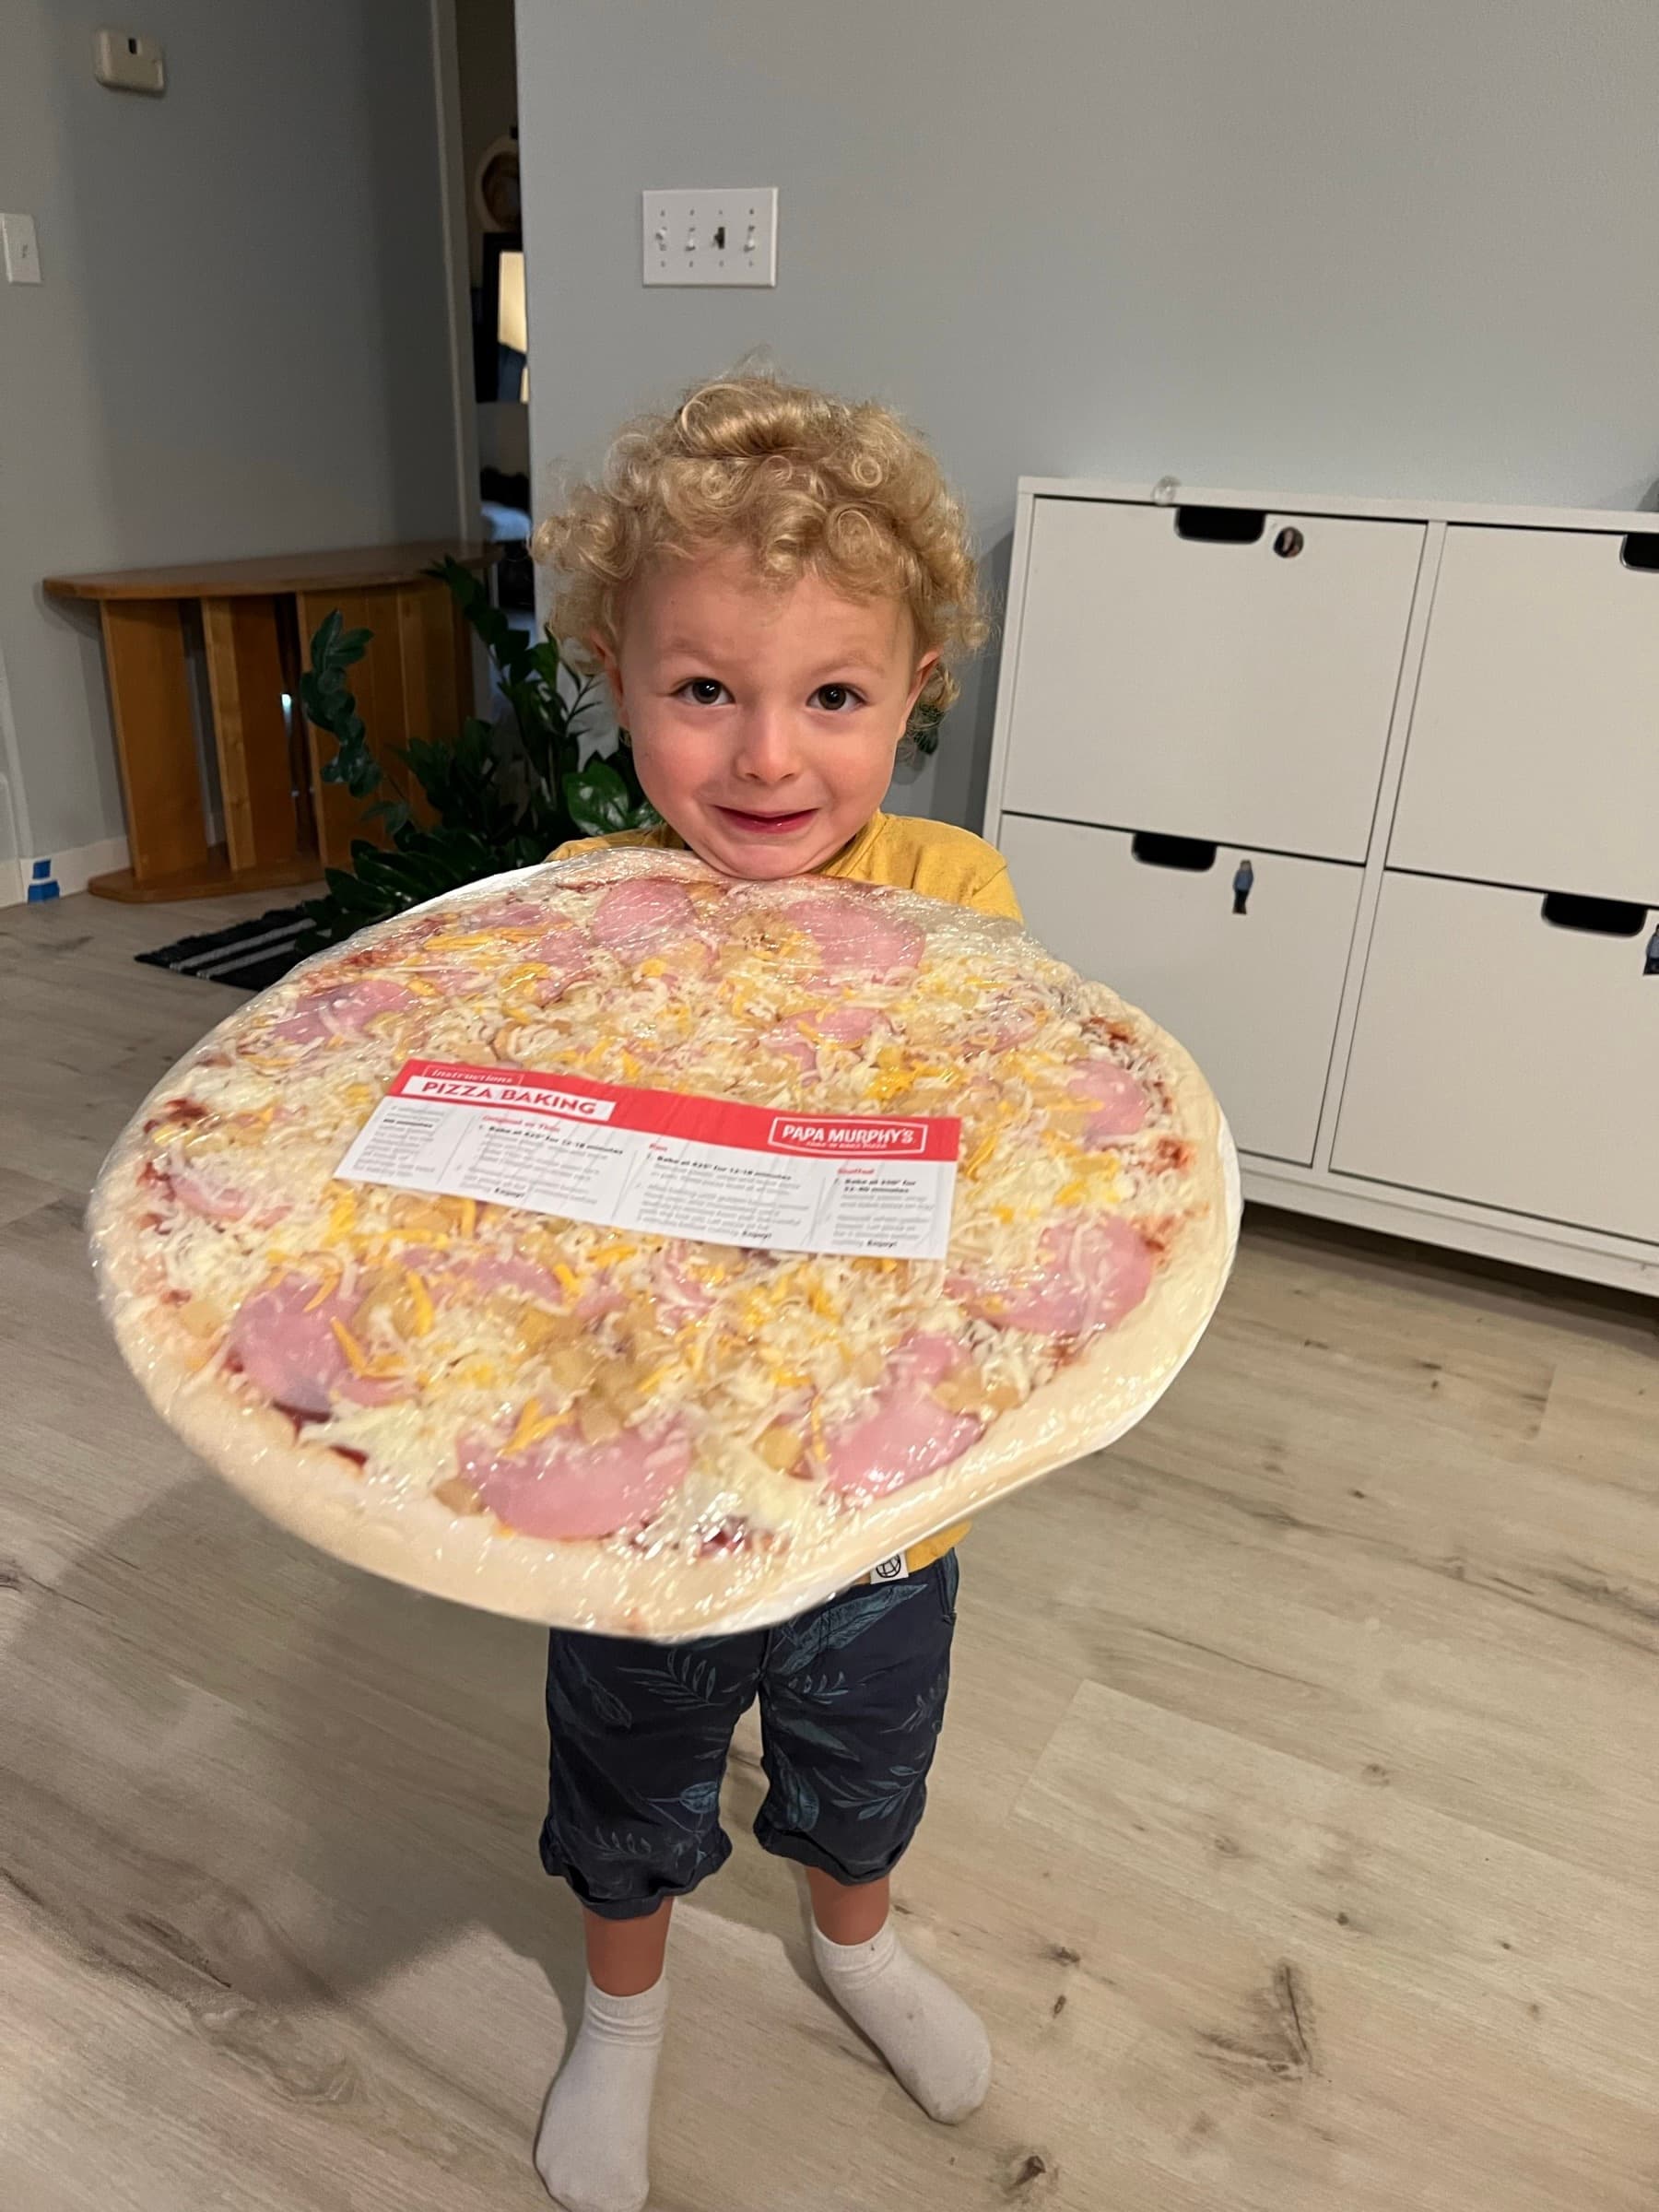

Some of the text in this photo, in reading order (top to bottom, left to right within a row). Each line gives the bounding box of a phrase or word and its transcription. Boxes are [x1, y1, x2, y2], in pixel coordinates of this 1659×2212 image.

[431, 1068, 513, 1083] Instructions
[421, 1081, 597, 1114] PIZZA BAKING
[488, 1125, 511, 1134] Bake
[586, 1144, 624, 1155] minutes
[782, 1124, 915, 1144] PAPA MURPHY'S
[657, 1155, 679, 1165] Bake
[753, 1171, 792, 1181] minutes
